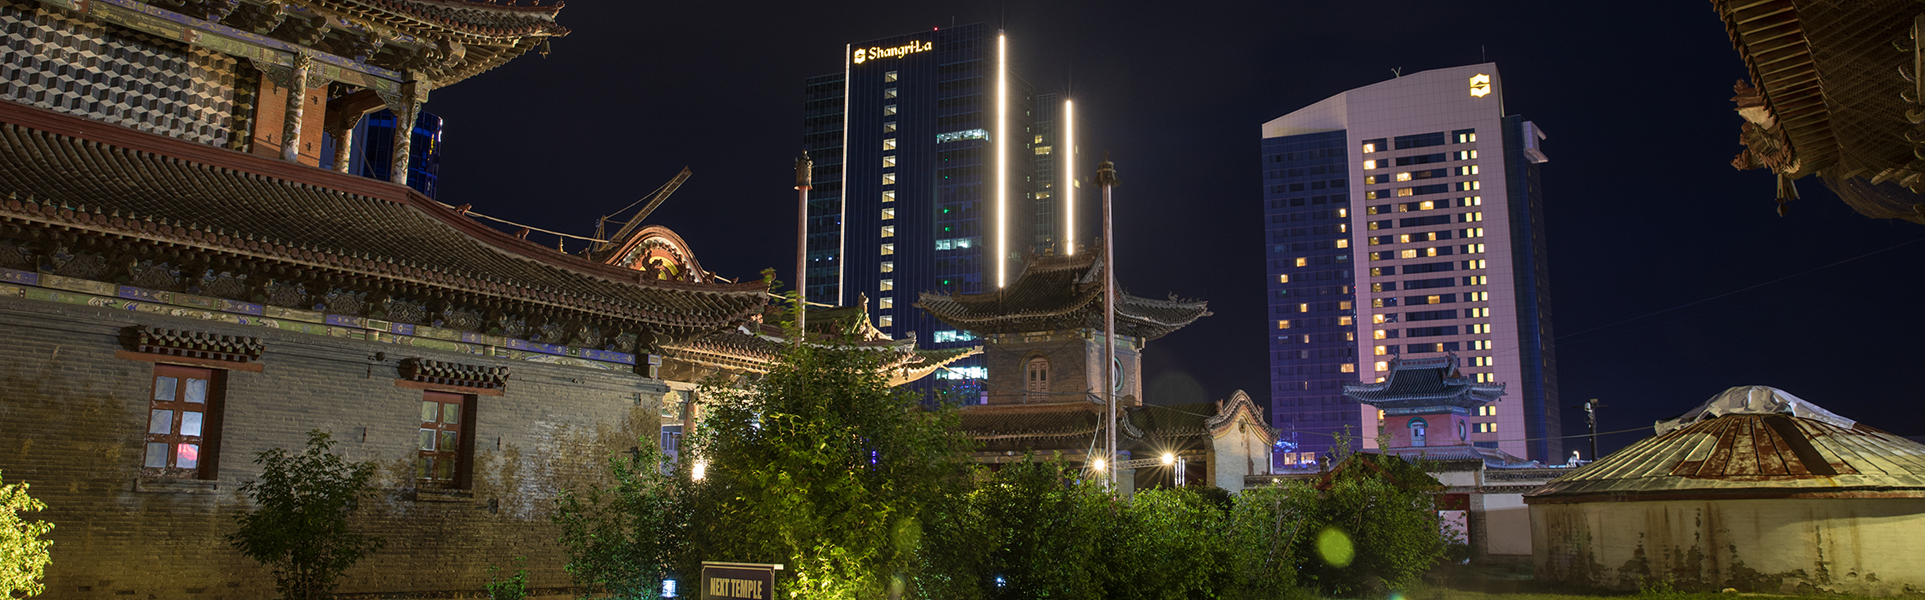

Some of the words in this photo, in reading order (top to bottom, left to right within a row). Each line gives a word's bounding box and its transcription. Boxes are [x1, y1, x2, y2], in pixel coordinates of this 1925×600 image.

[868, 40, 932, 60] Shangri-La
[710, 577, 730, 597] NEXT
[731, 578, 763, 599] TEMPLE
